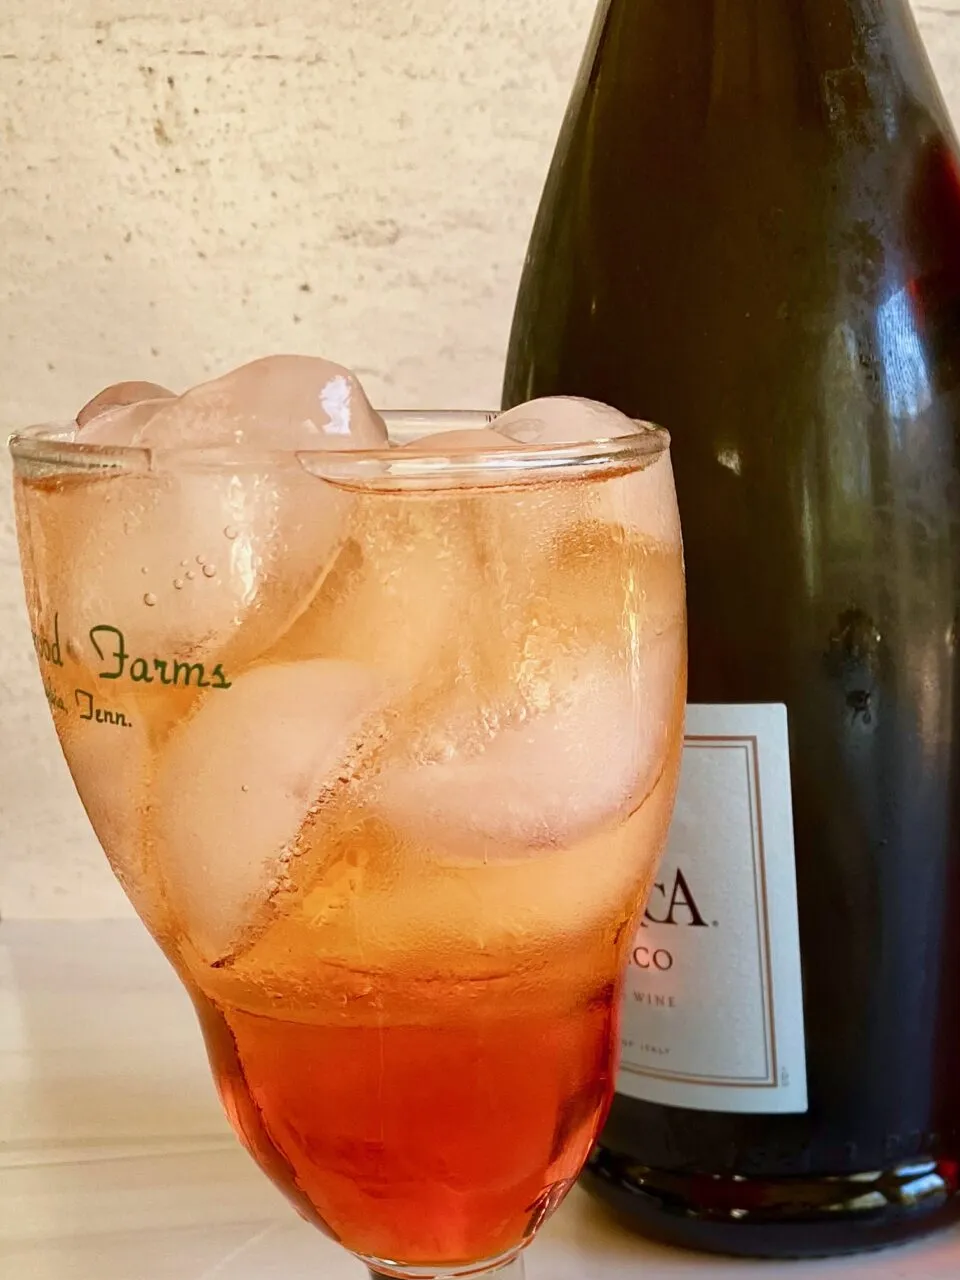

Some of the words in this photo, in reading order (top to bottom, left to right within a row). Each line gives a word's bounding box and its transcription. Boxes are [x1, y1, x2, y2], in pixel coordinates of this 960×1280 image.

[89, 624, 232, 690] Farms
[75, 688, 133, 728] Tenn.
[628, 945, 673, 971] CO
[633, 990, 676, 1008] WINE
